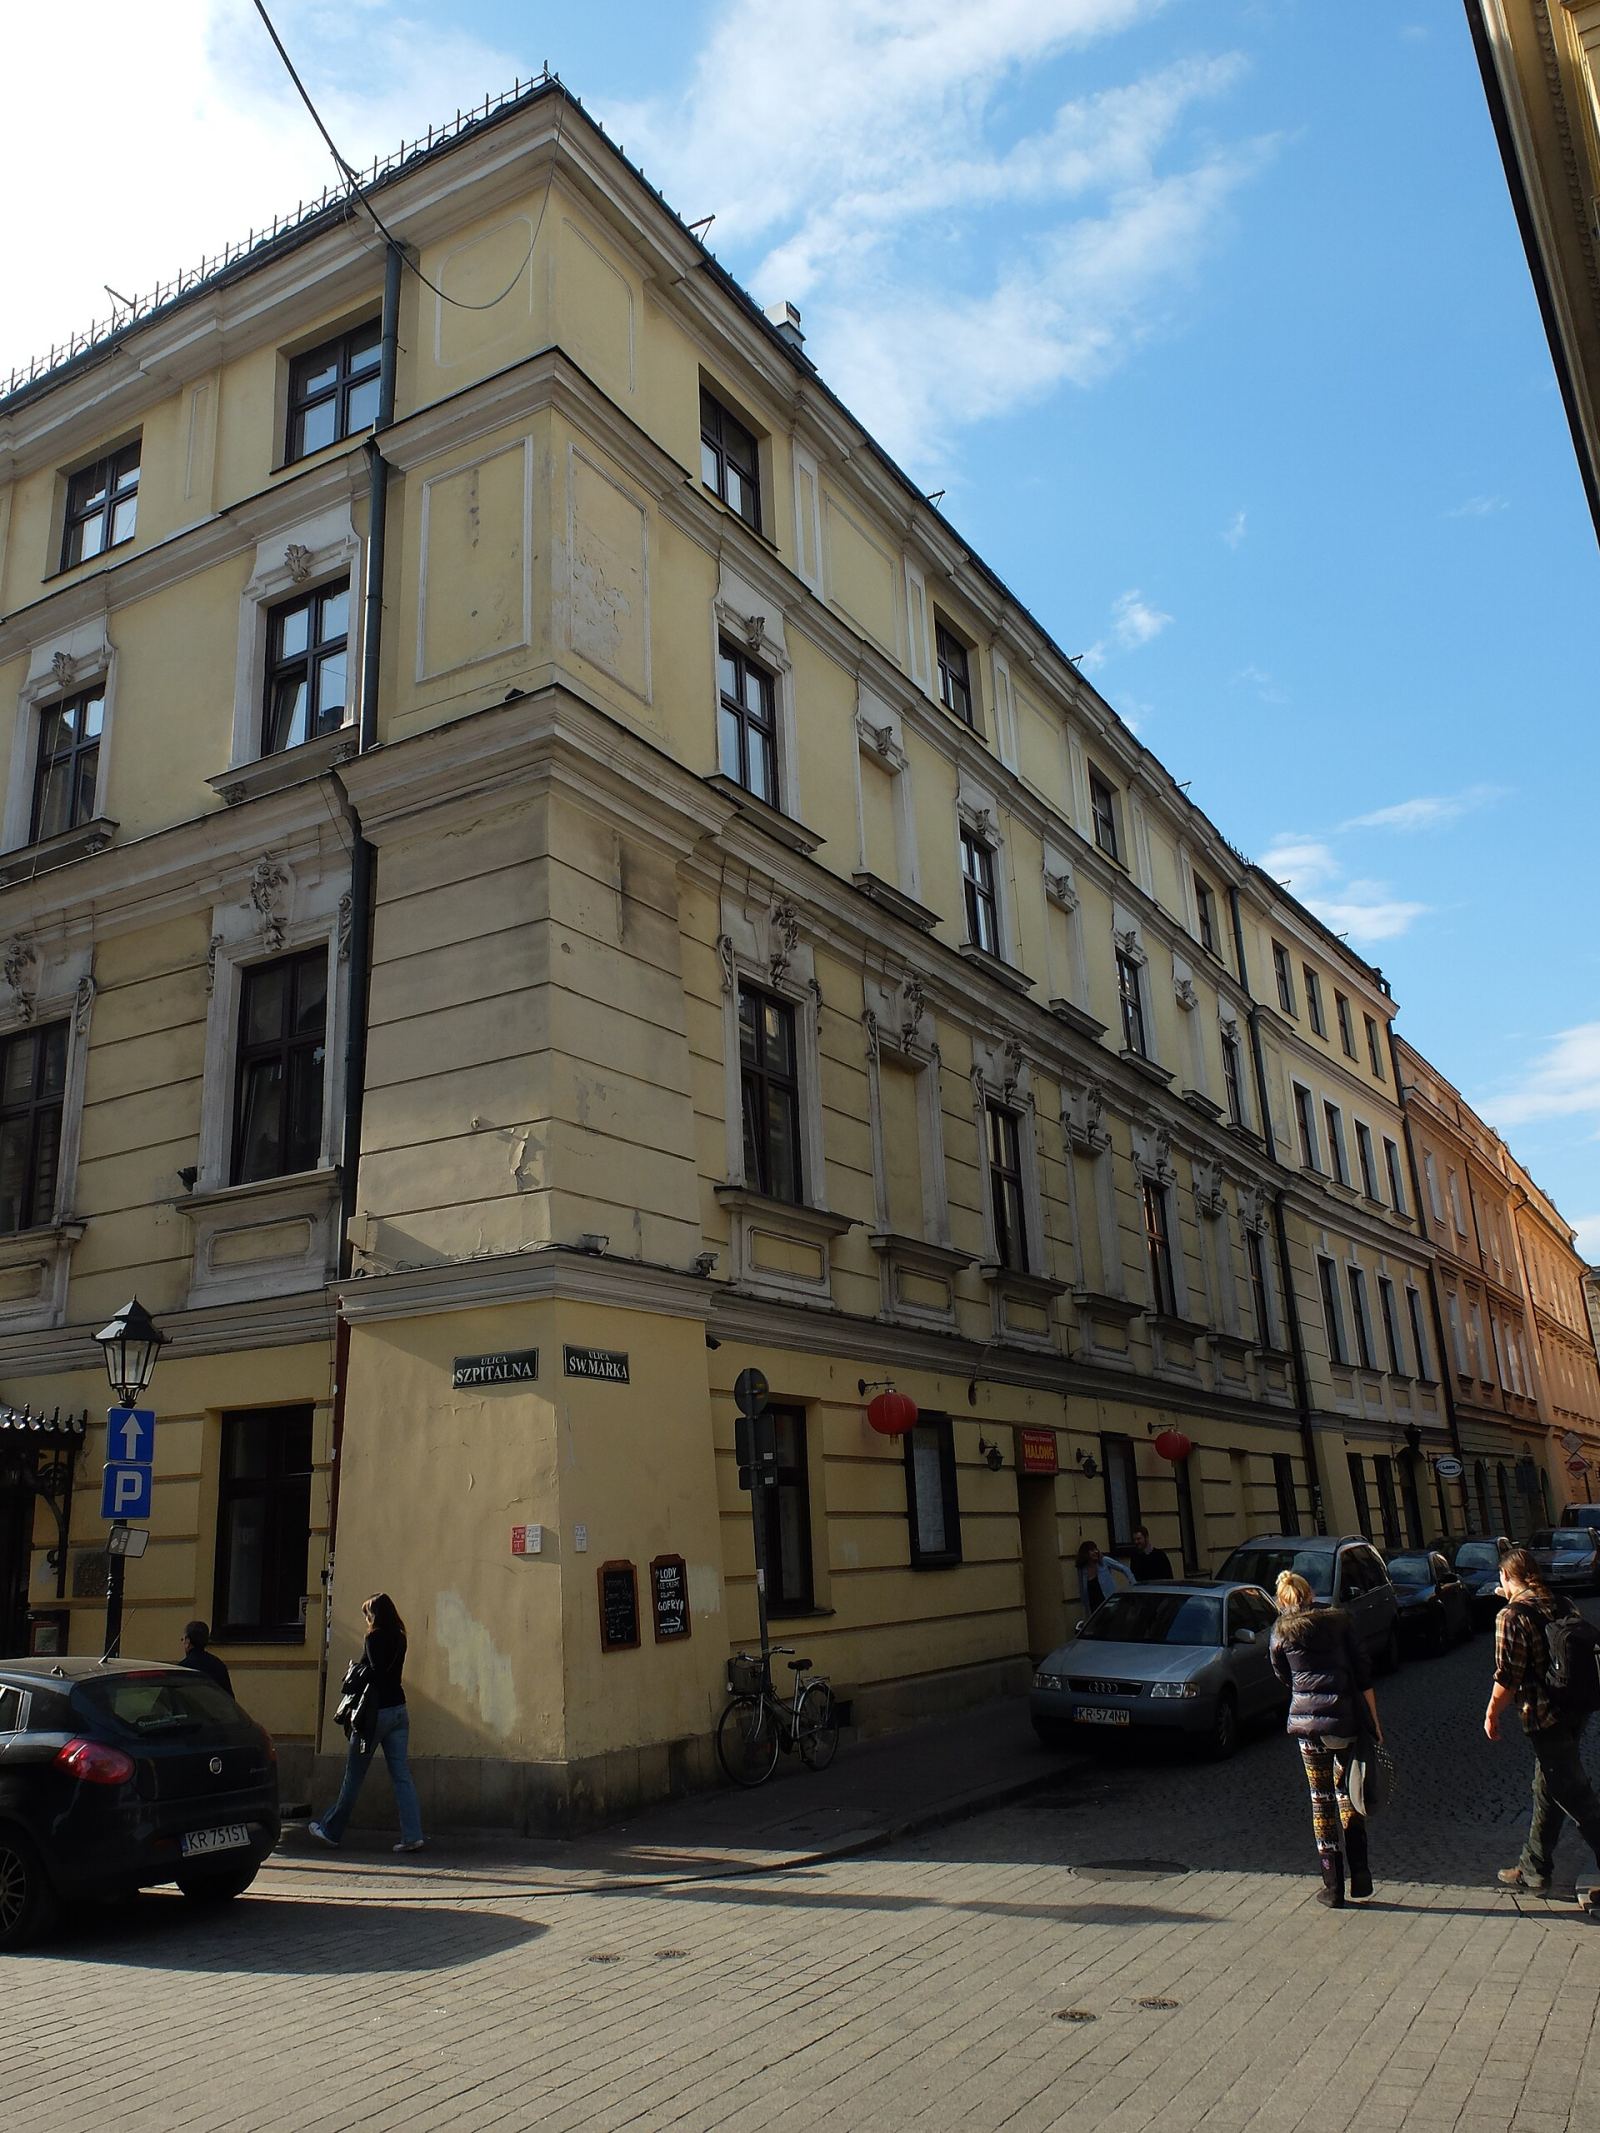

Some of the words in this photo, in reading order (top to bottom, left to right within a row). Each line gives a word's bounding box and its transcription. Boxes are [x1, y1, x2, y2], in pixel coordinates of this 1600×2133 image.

[480, 1355, 508, 1366] ULICA
[588, 1351, 610, 1361] ULICA
[455, 1361, 533, 1384] SZPITALNA
[114, 1470, 143, 1513] P
[659, 1567, 677, 1579] LODY
[187, 1831, 209, 1850] KR
[209, 1824, 246, 1846] 751ST
